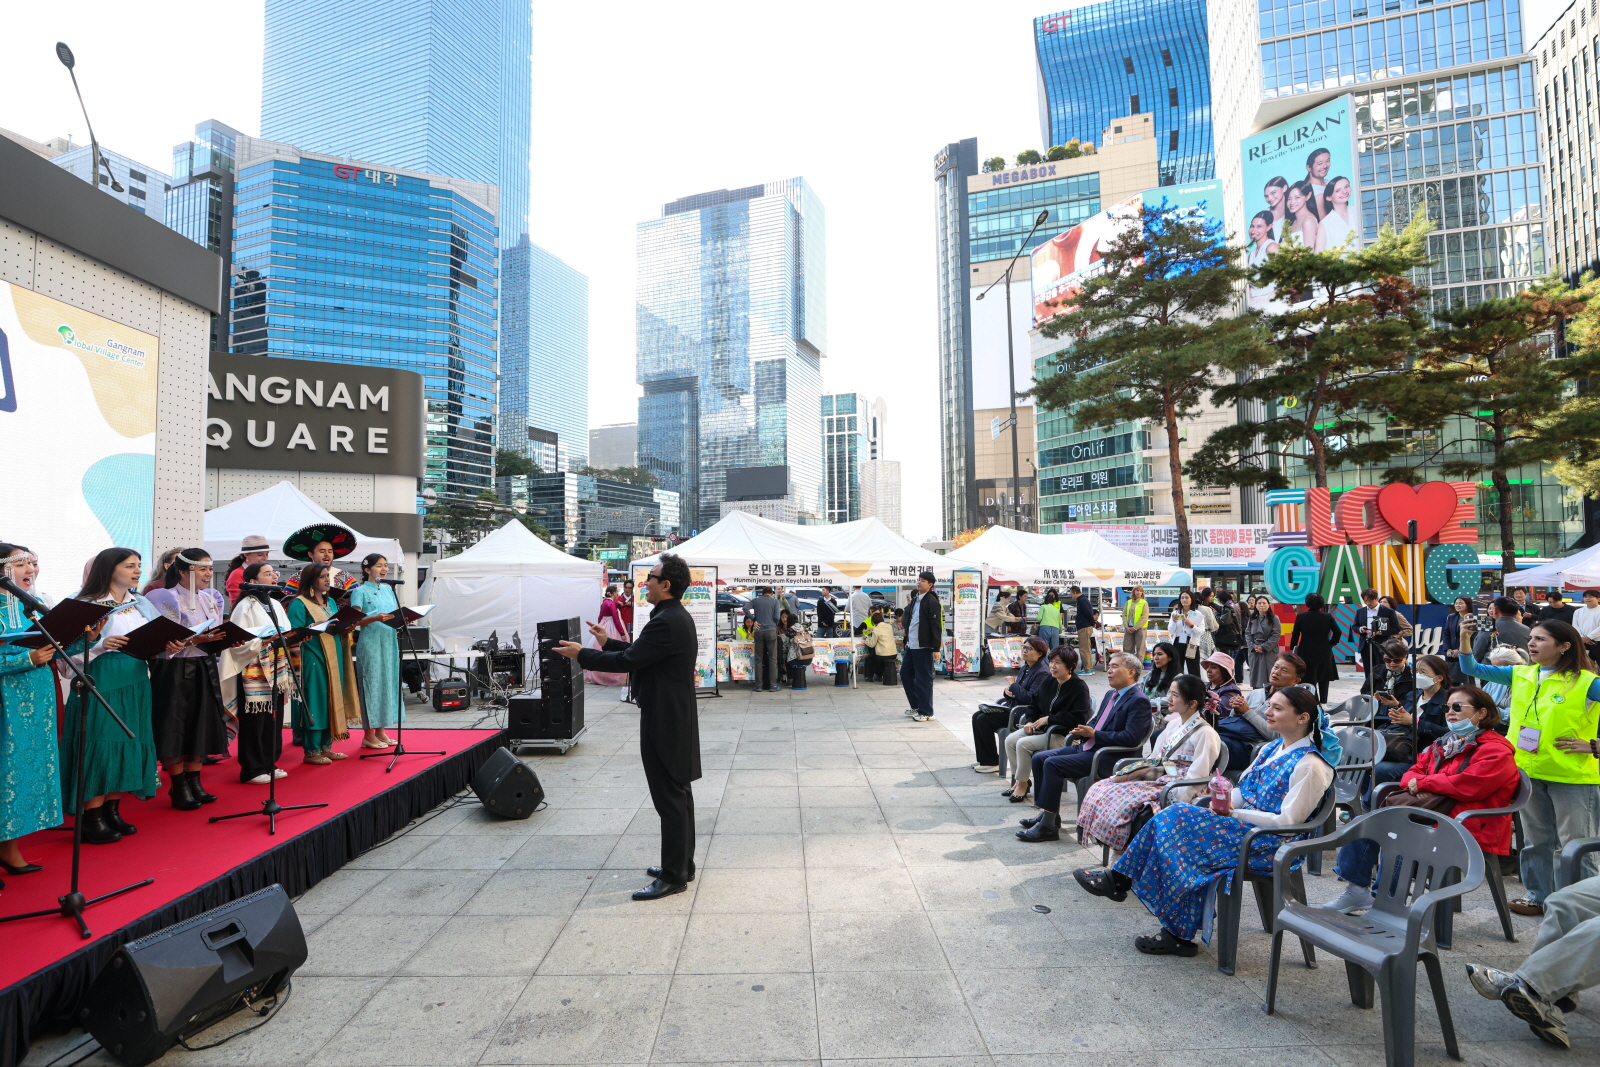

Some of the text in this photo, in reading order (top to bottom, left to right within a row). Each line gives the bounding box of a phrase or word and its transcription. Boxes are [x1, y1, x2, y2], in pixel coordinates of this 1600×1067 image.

[1042, 14, 1073, 32] GT
[1260, 134, 1329, 164] Rewrite Your Story
[333, 164, 399, 187] GT 대각
[992, 165, 1056, 185] MEGABOX
[95, 346, 120, 361] Village
[121, 355, 144, 367] Center
[106, 339, 145, 358] Gangnam
[1071, 440, 1105, 459] Onlif
[1060, 471, 1108, 491] 온리프 의원
[1076, 500, 1117, 517] 아인스치과
[748, 563, 821, 576] 훈민정음키링
[1264, 543, 1482, 605] GANG
